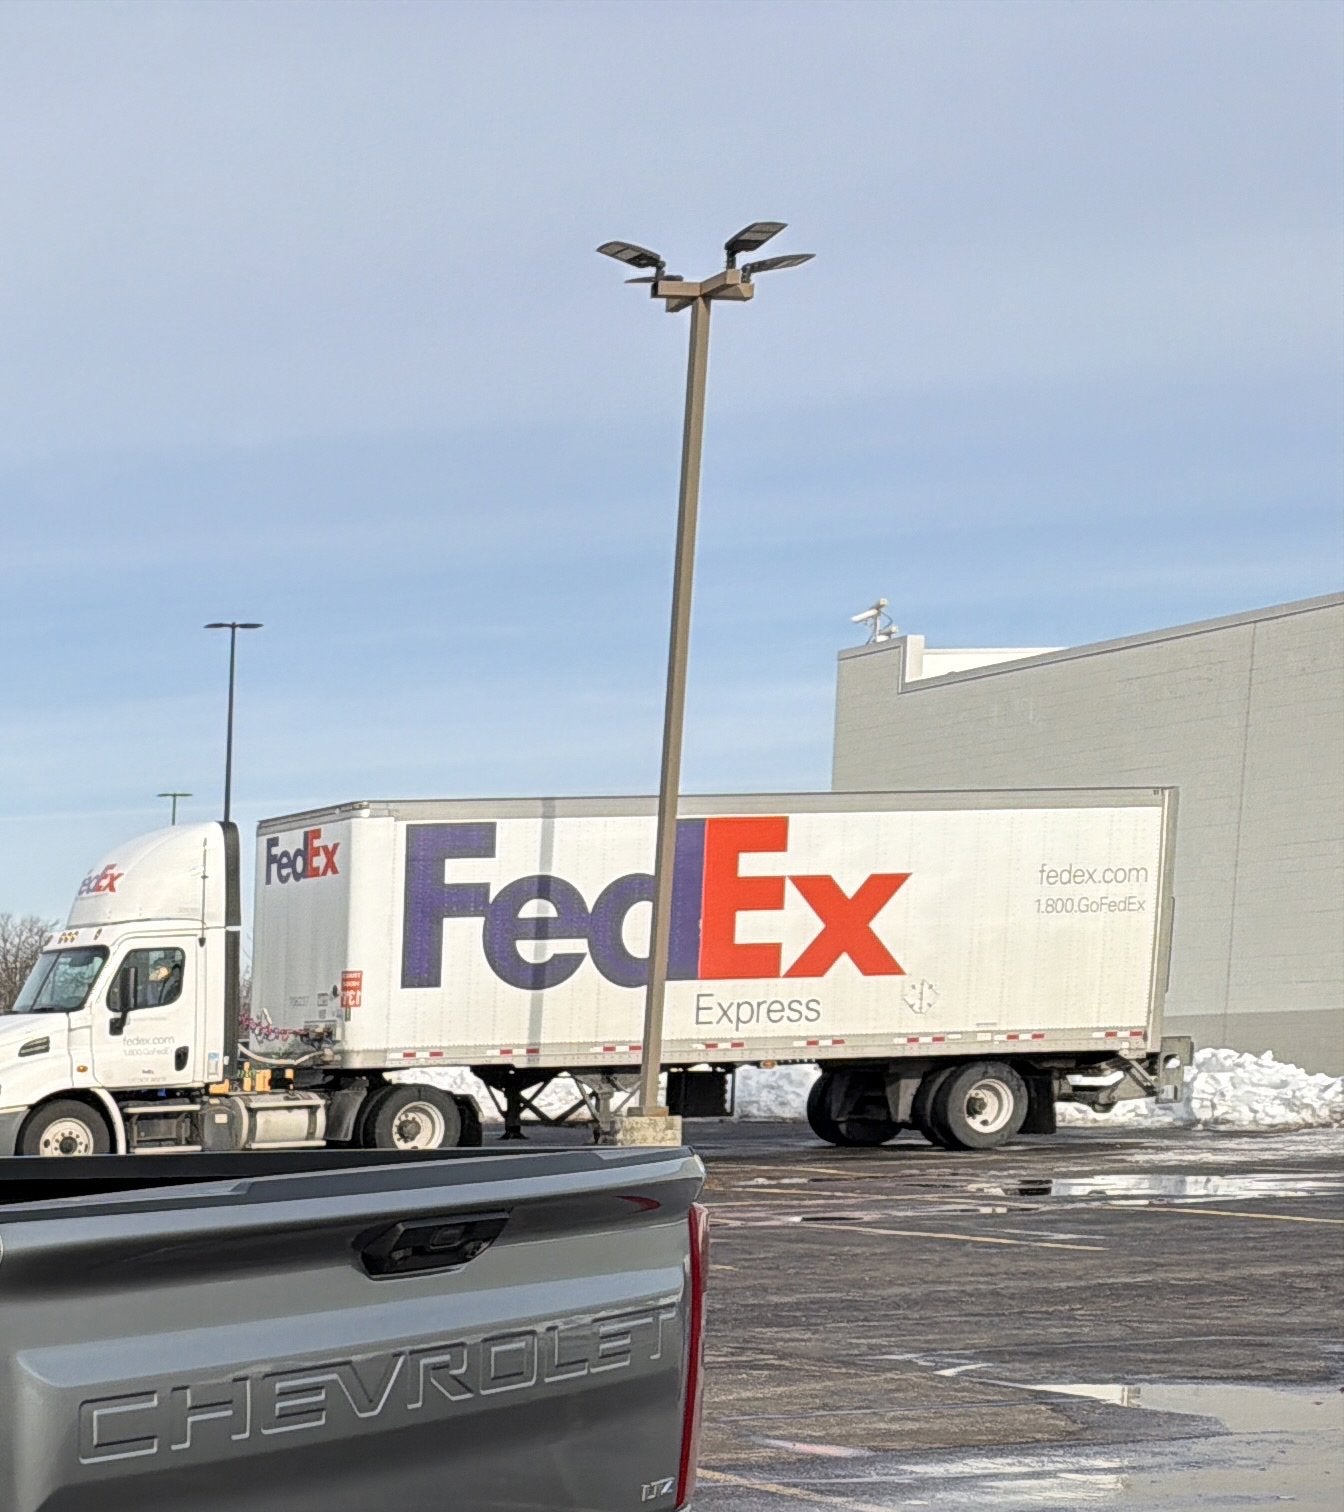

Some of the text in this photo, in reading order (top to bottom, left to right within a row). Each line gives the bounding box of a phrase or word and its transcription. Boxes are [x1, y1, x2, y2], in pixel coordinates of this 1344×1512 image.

[265, 827, 340, 885] FedEx
[1039, 863, 1148, 885] fedex.com
[401, 815, 912, 990] FedEx
[1035, 896, 1146, 914] 1.800.GoFedEx
[695, 993, 821, 1031] Express
[78, 1301, 678, 1464] CHEVROLET
[640, 1476, 675, 1502] LTZ
